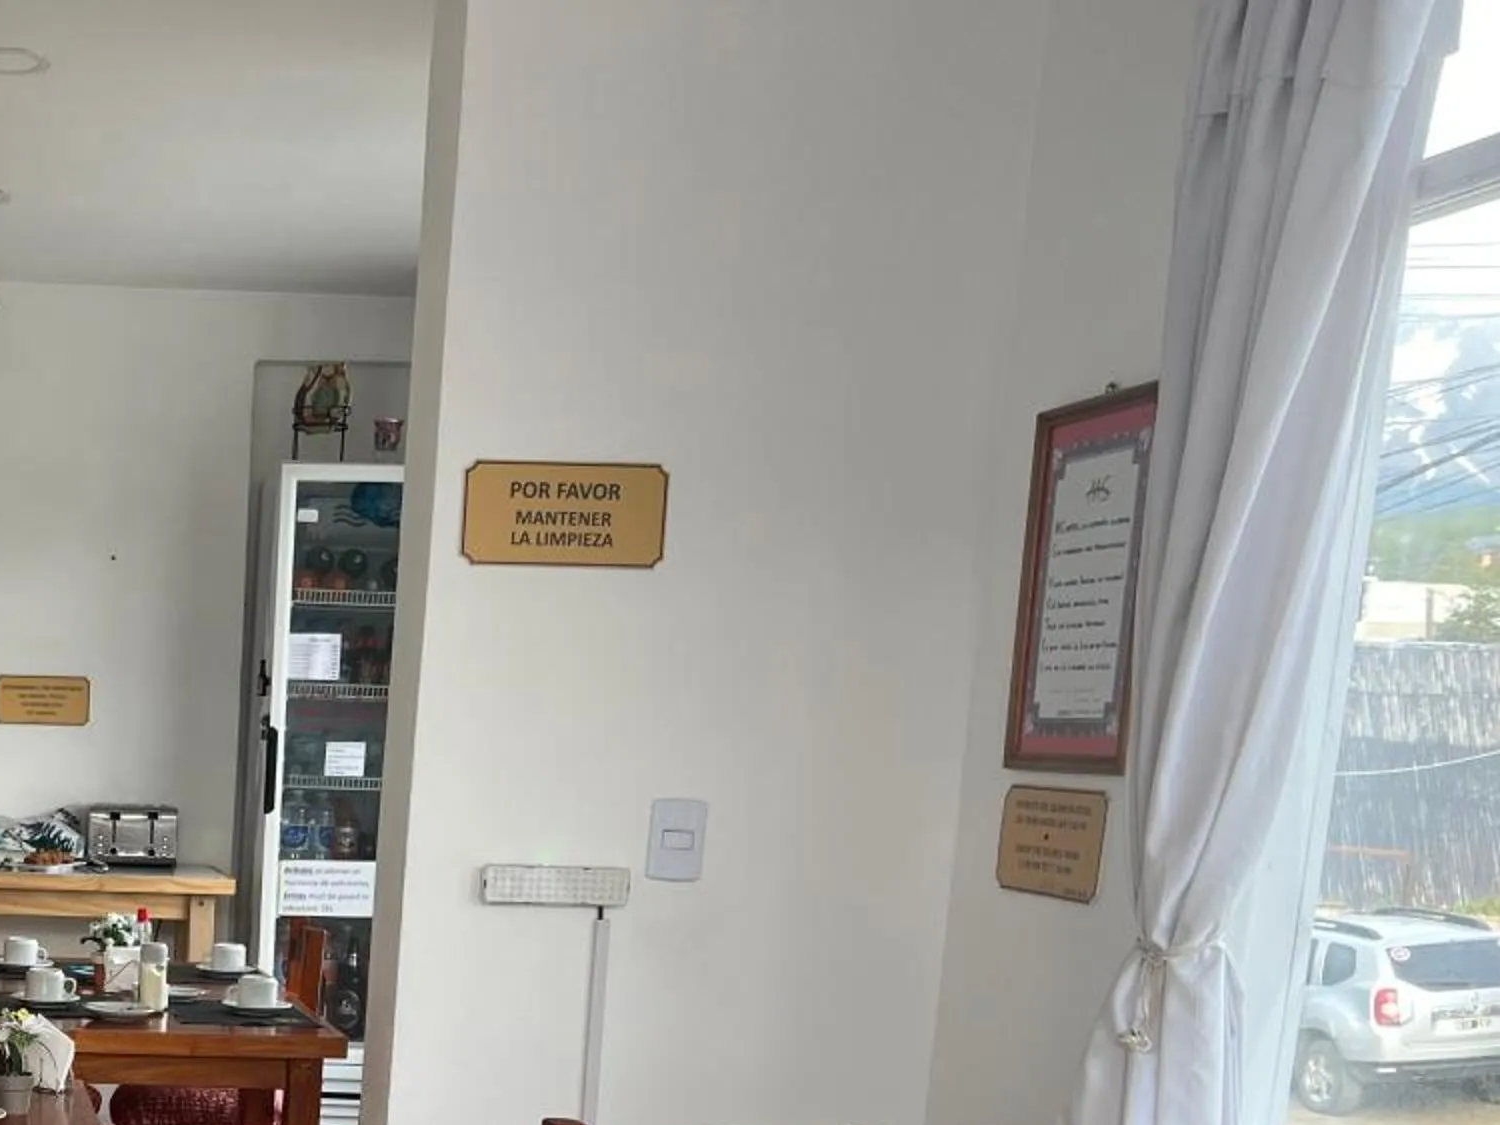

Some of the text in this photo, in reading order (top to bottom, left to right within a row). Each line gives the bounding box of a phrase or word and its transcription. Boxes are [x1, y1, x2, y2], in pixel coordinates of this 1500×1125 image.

[510, 481, 621, 501] POR FAVOR
[515, 510, 612, 527] MANTENER
[511, 531, 613, 548] LA LIMPIEZA
